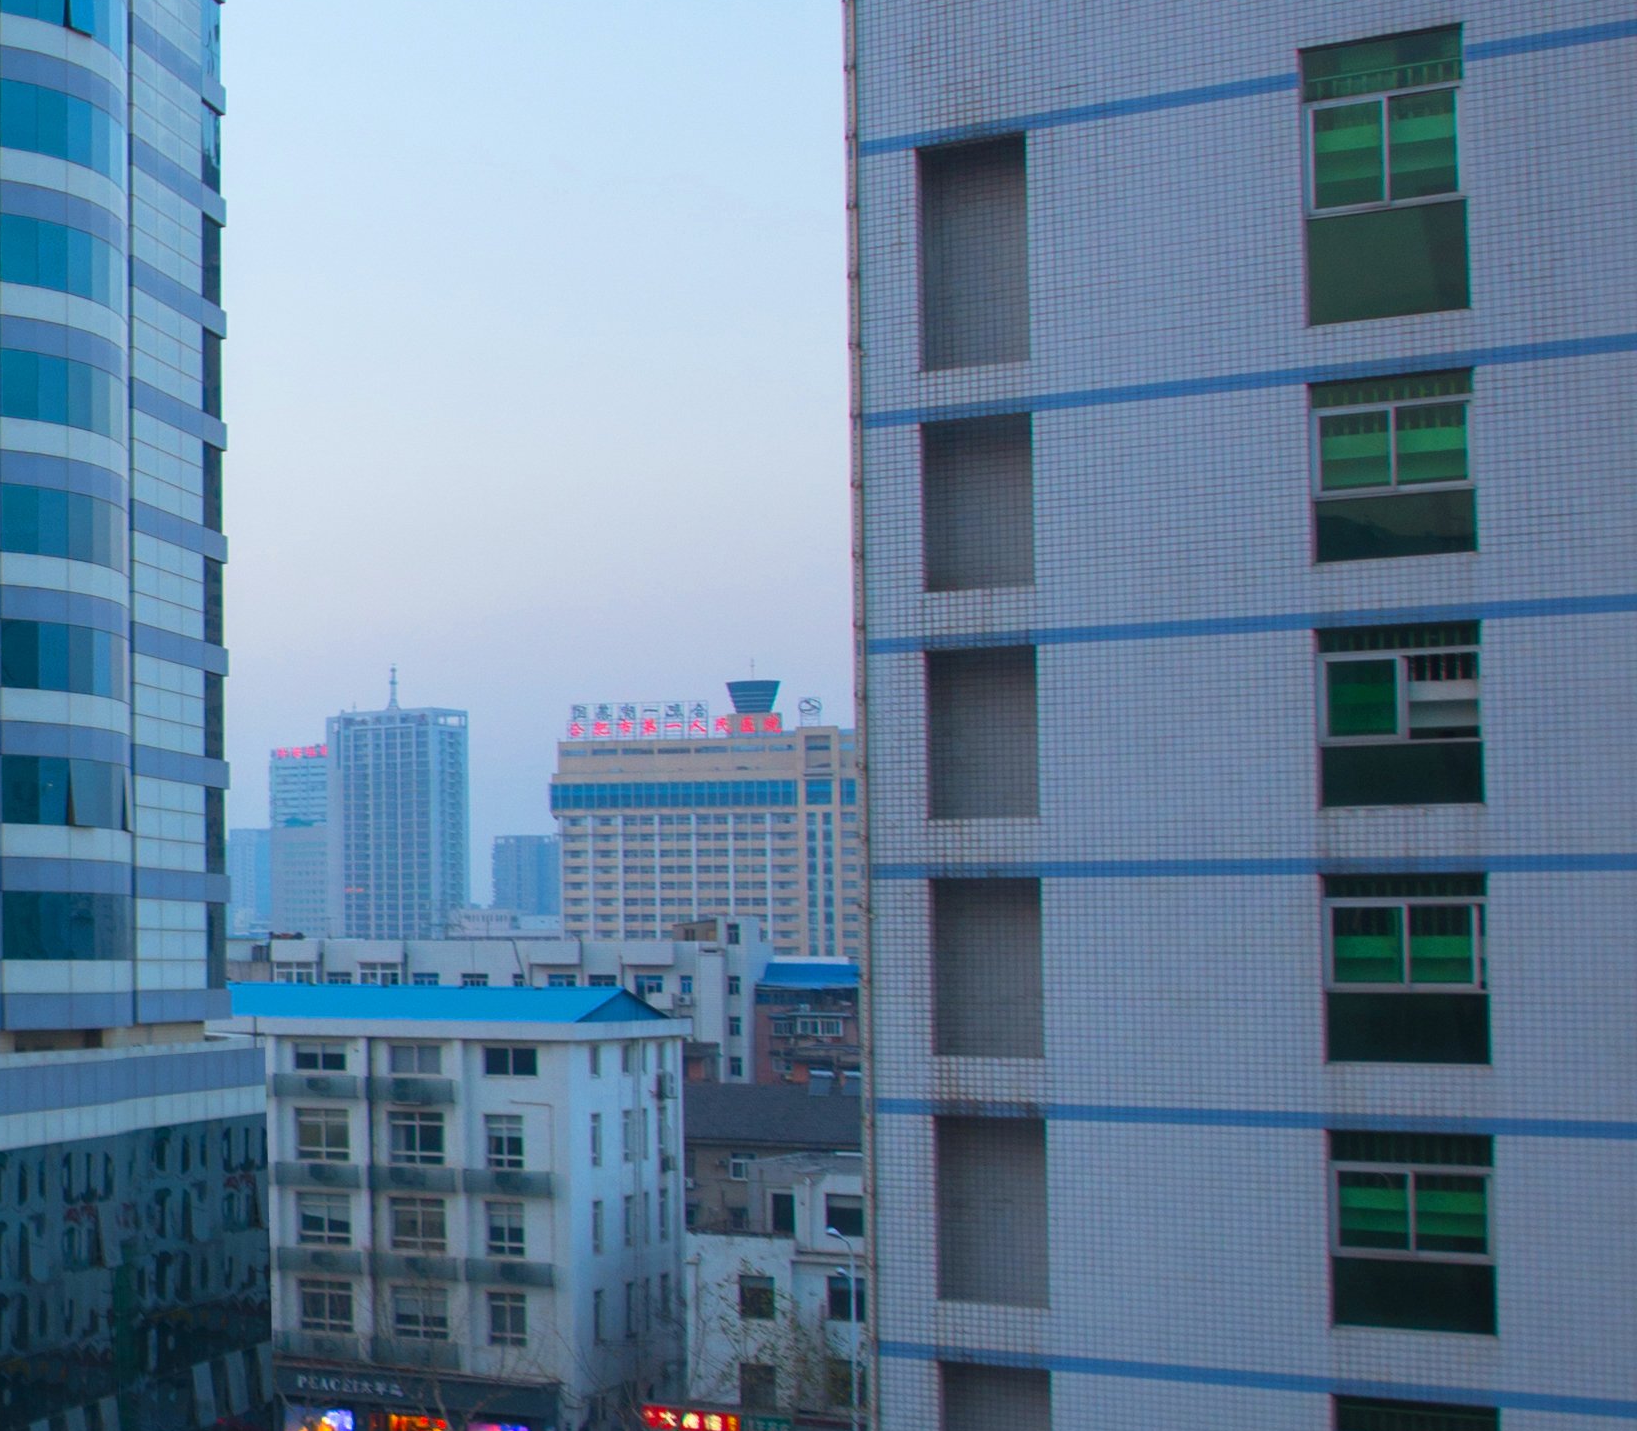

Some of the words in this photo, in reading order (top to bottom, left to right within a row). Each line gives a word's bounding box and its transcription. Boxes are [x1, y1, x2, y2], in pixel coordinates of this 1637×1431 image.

[569, 715, 783, 737] 合肥市第一人民医院
